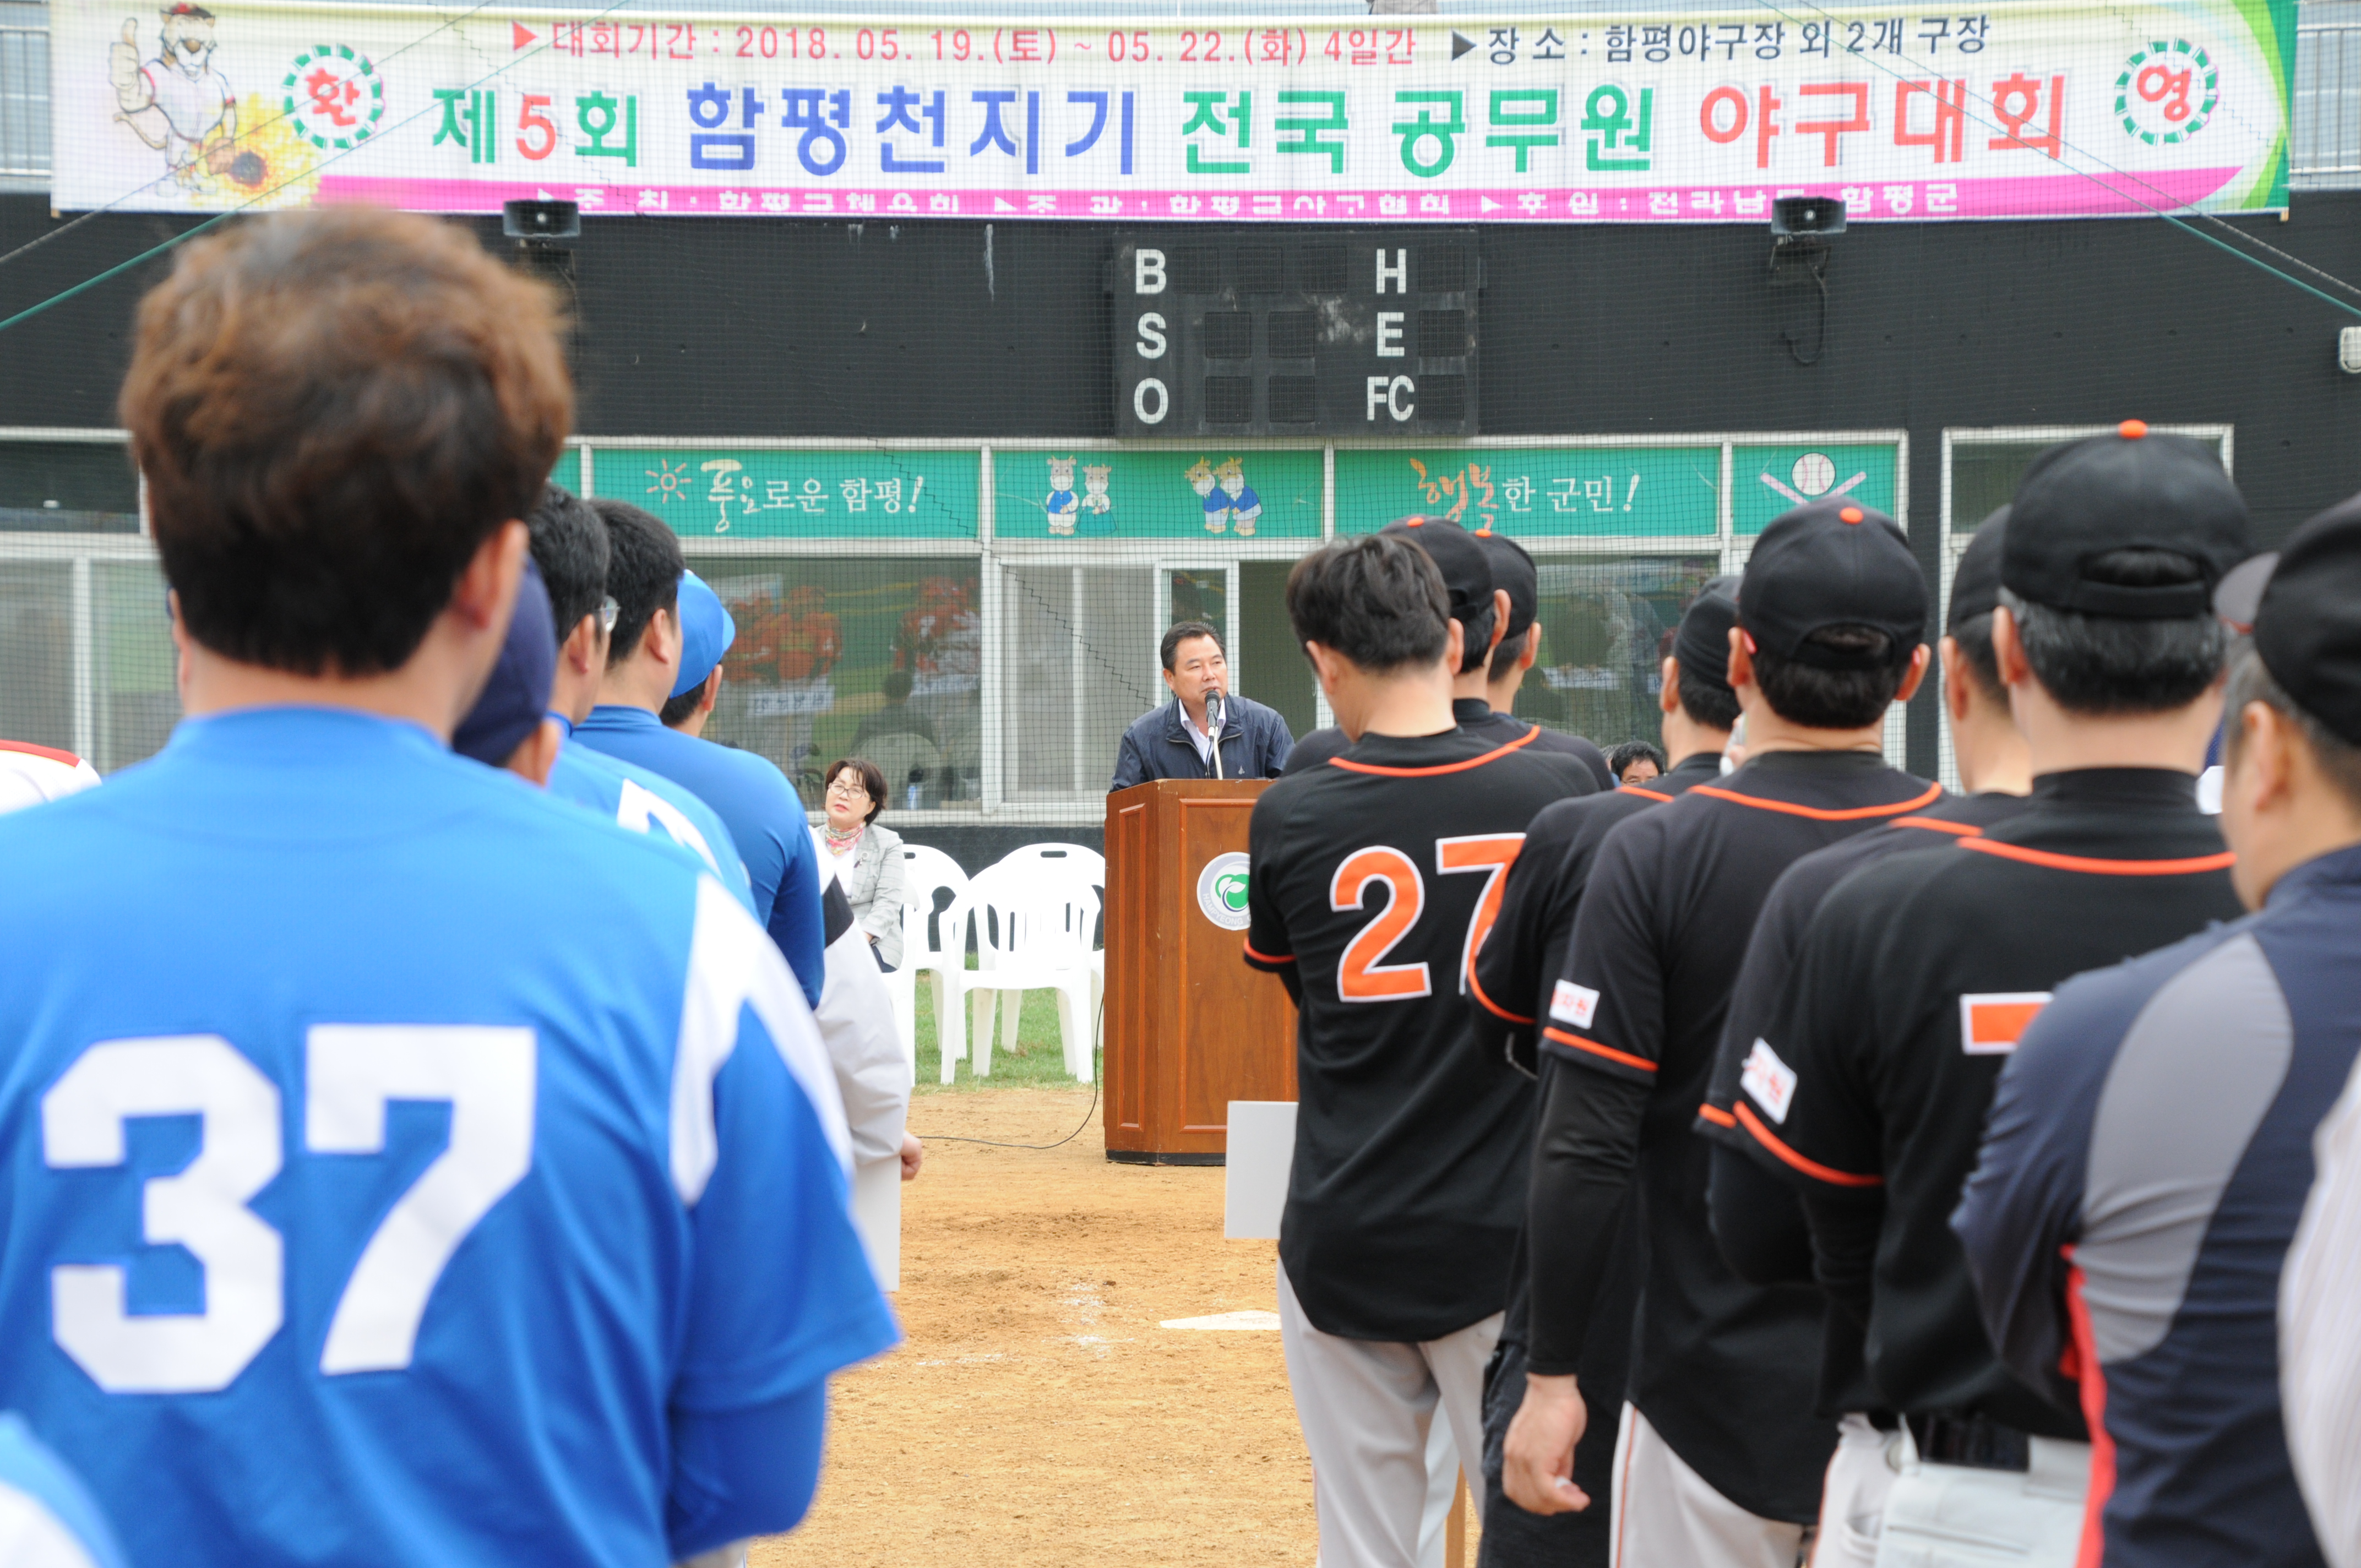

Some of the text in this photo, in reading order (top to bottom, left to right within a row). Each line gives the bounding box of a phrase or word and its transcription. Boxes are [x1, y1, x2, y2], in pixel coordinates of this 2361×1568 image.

[552, 22, 695, 59] 대회기간
[1324, 28, 1416, 65] 4일간
[1605, 21, 1786, 63] 함평야구장
[1799, 20, 1831, 58] 외
[1846, 17, 1905, 56] 2개
[1917, 14, 1990, 54] 구장
[304, 67, 361, 127] 환
[2136, 64, 2193, 122] 영
[432, 72, 2065, 178] 제5회 함평천지기 전국 공무원 야구대회
[1135, 248, 1167, 294] B
[1376, 248, 1407, 294] H
[1136, 312, 1167, 359] S
[1377, 312, 1405, 357] E
[1134, 378, 1169, 424] O
[1367, 375, 1415, 421] FC
[700, 459, 924, 533] 풍요로운 함평!
[1408, 458, 1640, 531] 행복한 군민!
[1203, 892, 1244, 925] HAMPYEONG
[1329, 832, 1527, 1003] 27
[41, 1023, 537, 1395] 37
